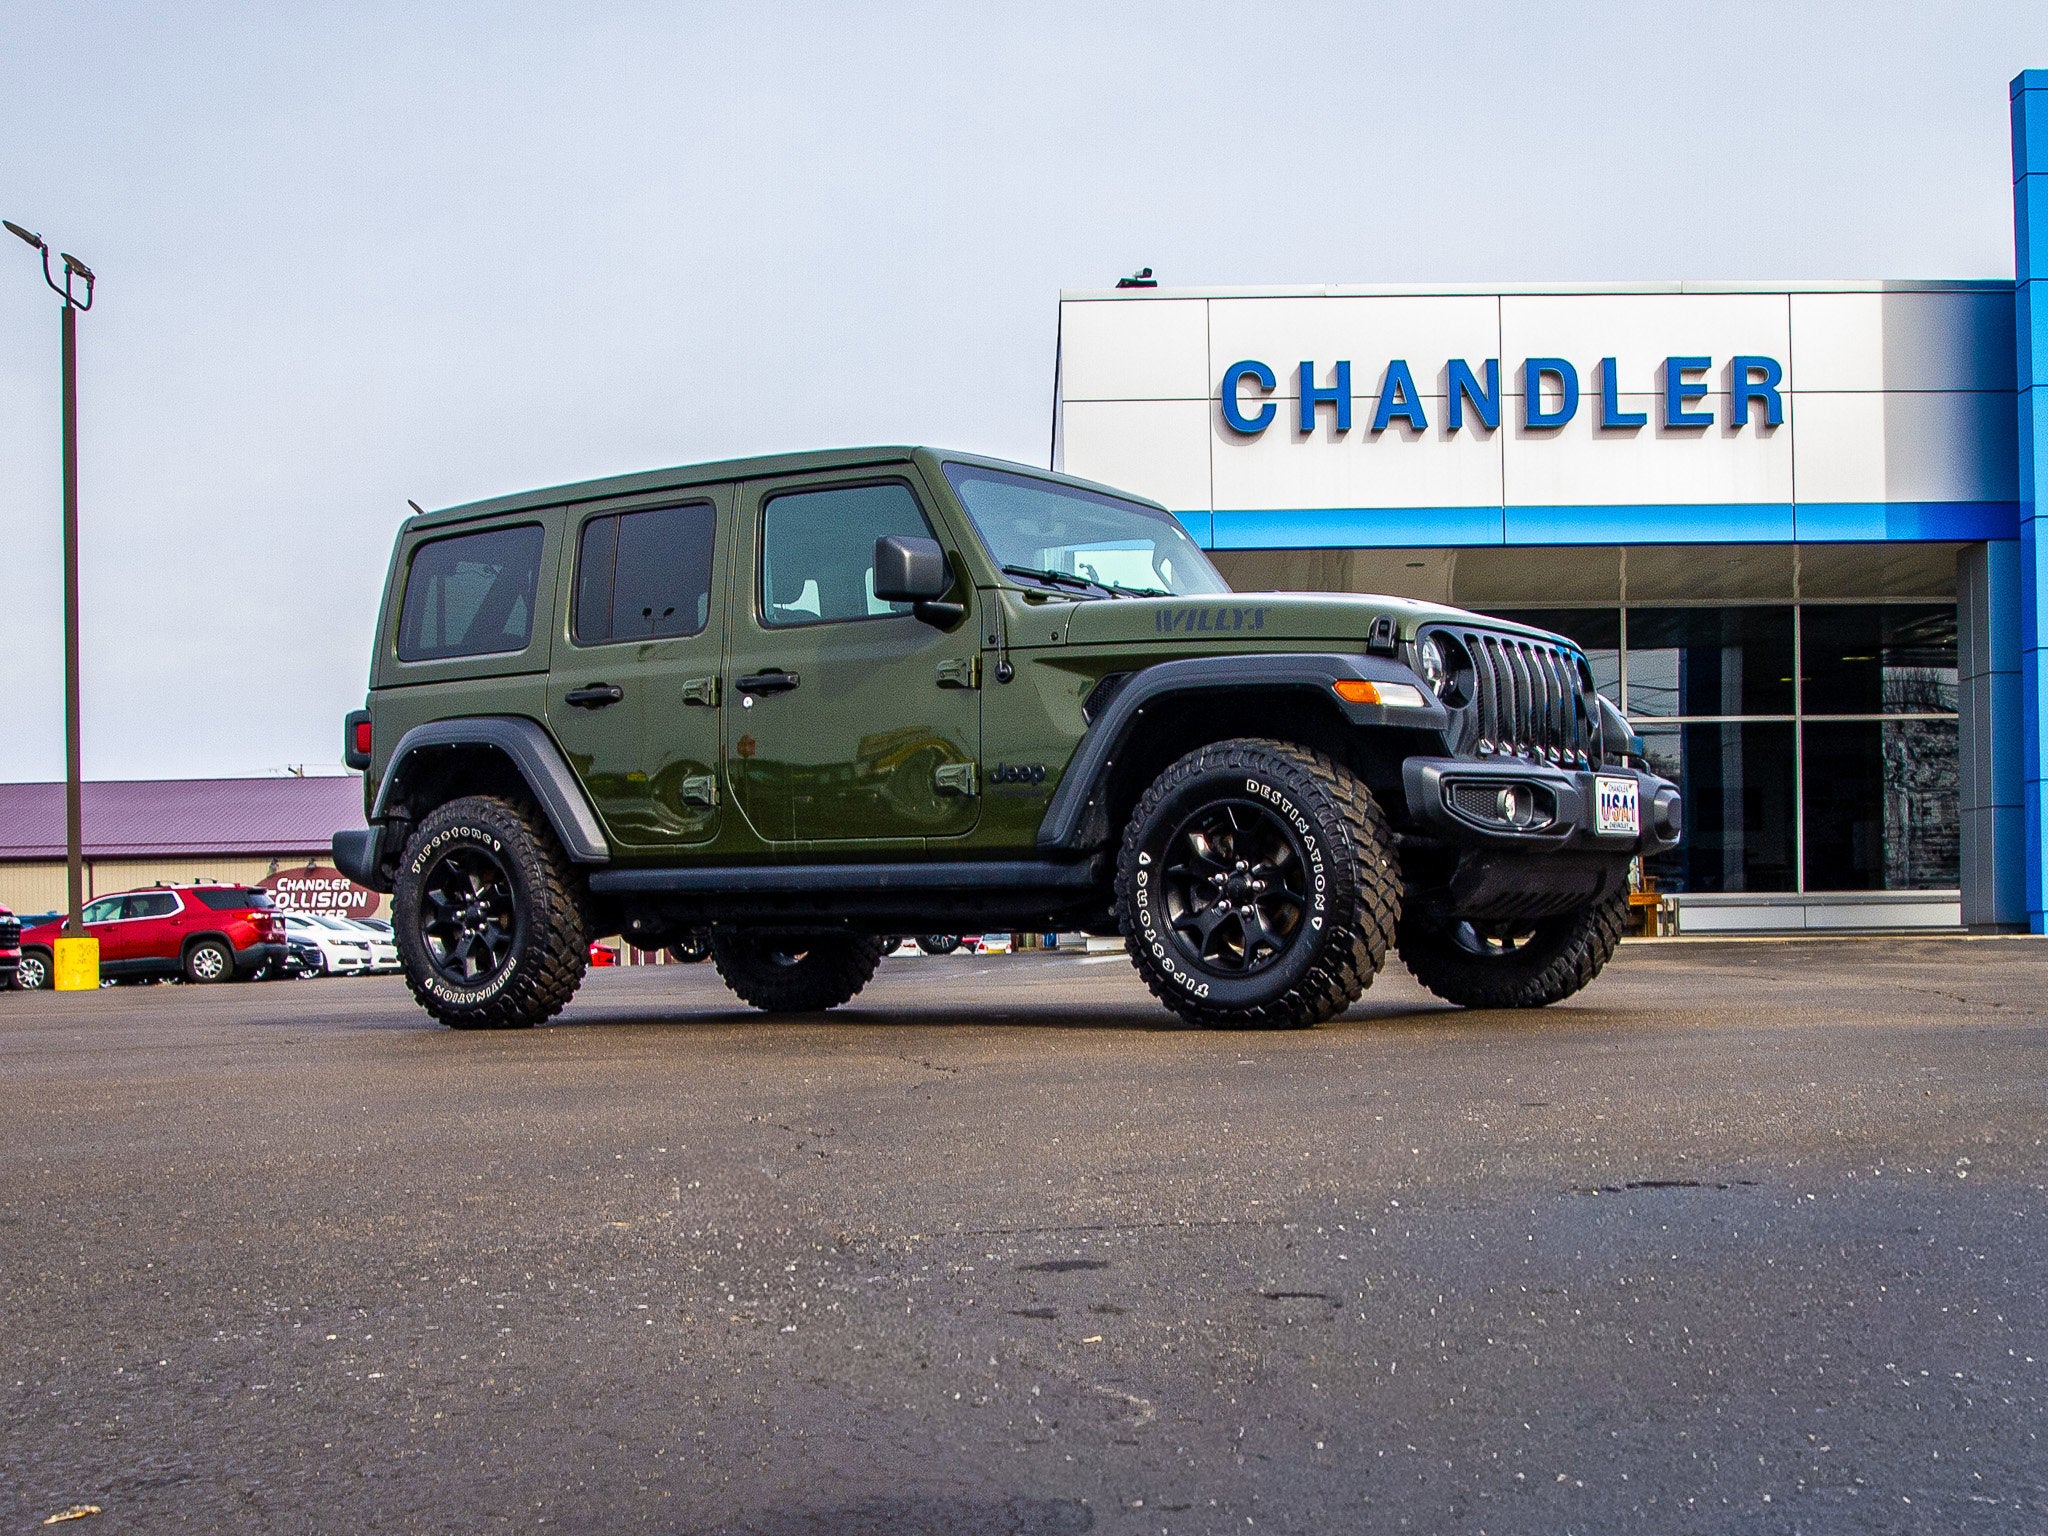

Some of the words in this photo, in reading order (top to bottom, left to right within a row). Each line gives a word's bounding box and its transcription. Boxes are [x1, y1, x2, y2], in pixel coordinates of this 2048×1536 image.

[1221, 355, 1785, 435] CHANDLER
[1155, 607, 1271, 632] WILLYS
[990, 762, 1046, 786] Jeep
[1246, 779, 1326, 911] DESTINATION
[276, 878, 351, 891] CHANDLER
[433, 956, 517, 1004] DESTINATION
